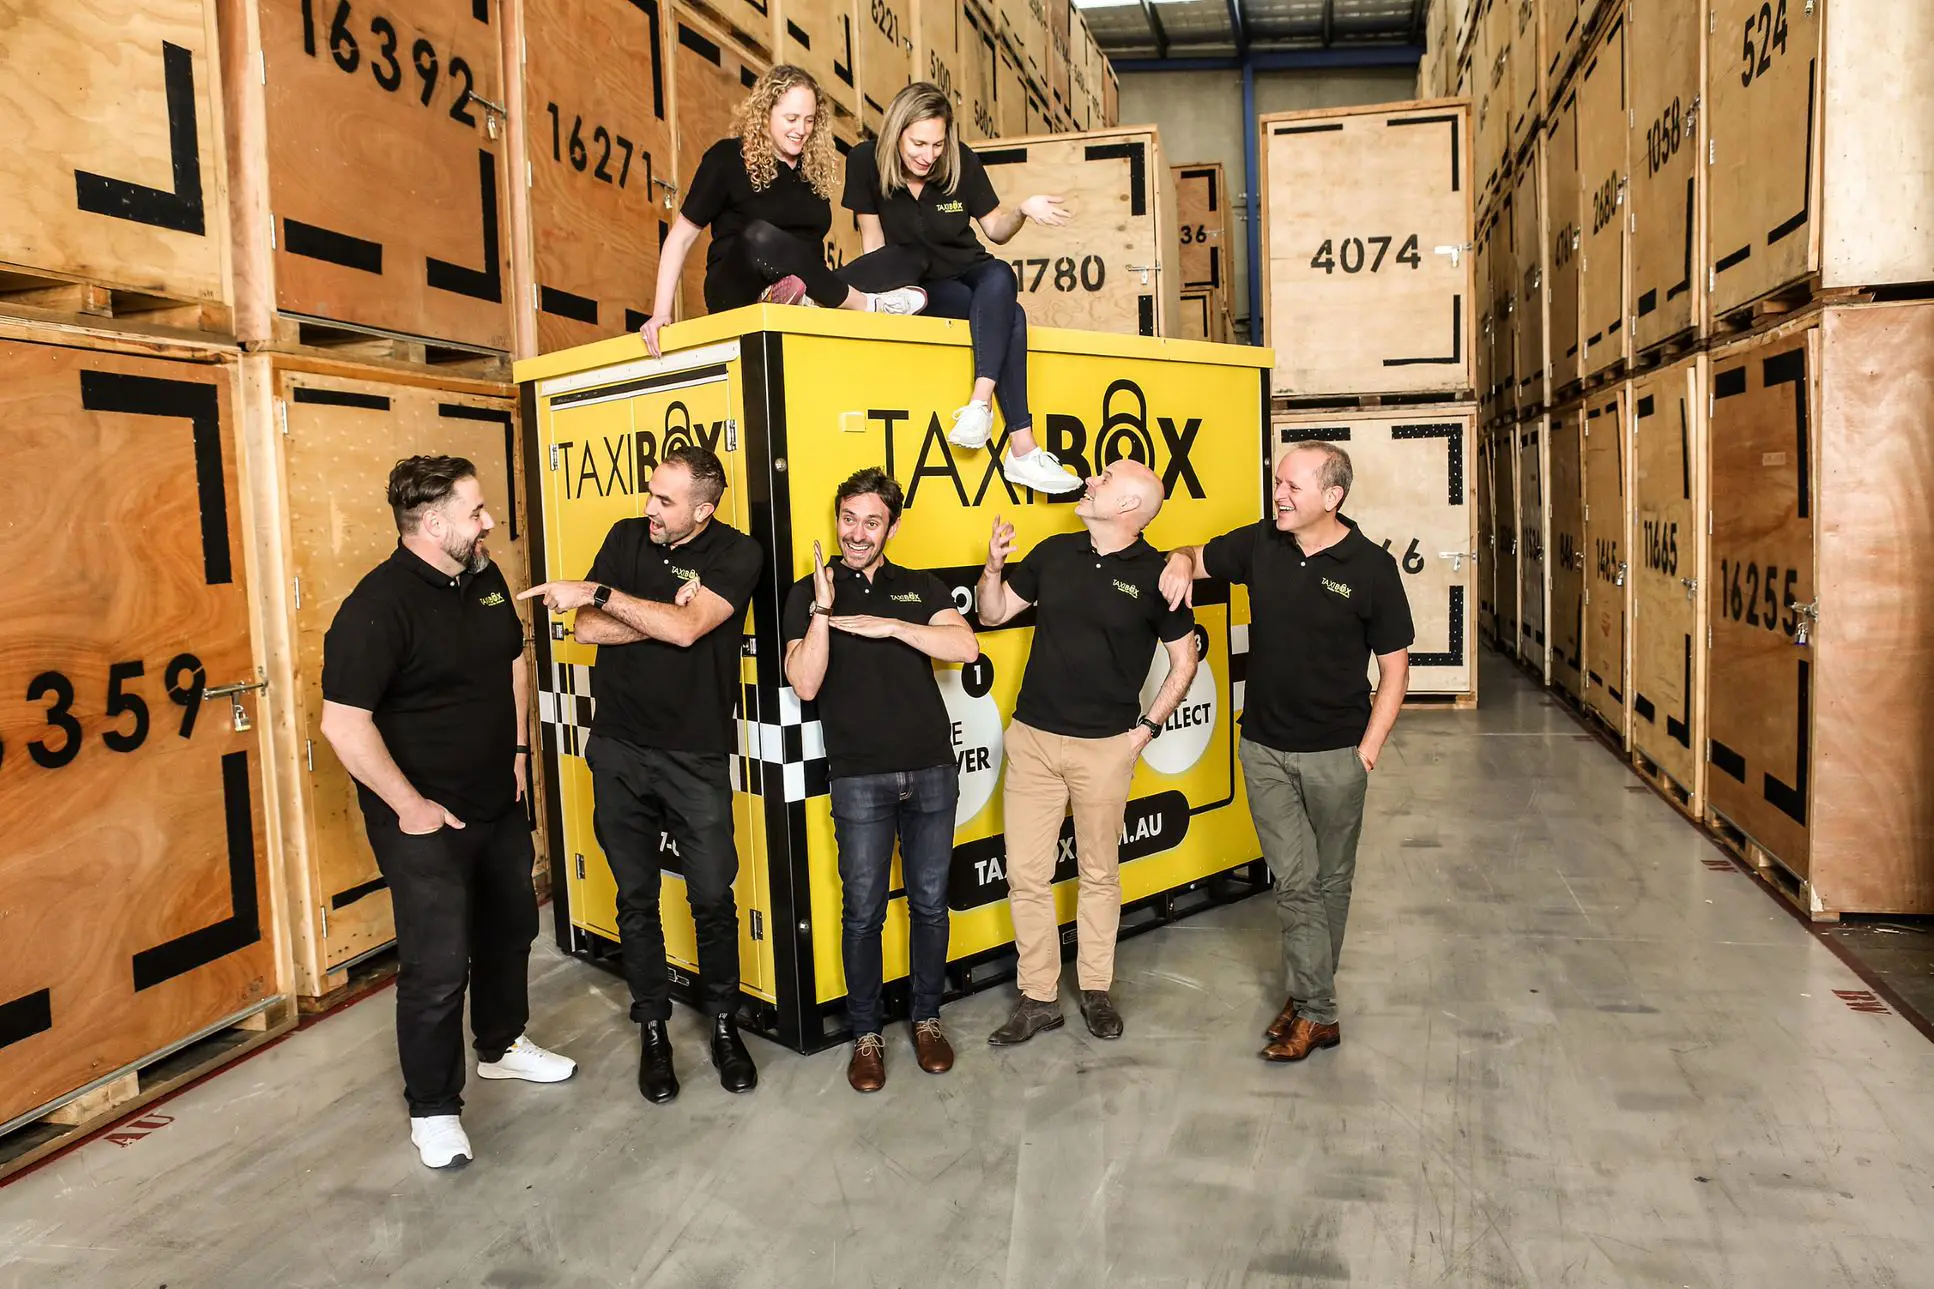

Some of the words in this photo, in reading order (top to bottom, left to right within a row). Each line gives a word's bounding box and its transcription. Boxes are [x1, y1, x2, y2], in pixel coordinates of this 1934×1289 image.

[301, 0, 476, 128] 16392
[1741, 0, 1788, 88] 524
[930, 48, 951, 97] 5100
[547, 101, 653, 203] 16271
[1647, 95, 1681, 179] 1058
[1592, 169, 1617, 236] 2680
[1180, 224, 1208, 245] 36
[1310, 233, 1422, 275] 4074
[1011, 254, 1105, 293] 1780
[867, 378, 1206, 509] TAXBOX
[1596, 538, 1617, 585] 1465
[1643, 520, 1677, 577] 11665
[1113, 579, 1139, 598] TAXIBOX
[1322, 577, 1351, 598] TAXIBOX
[1721, 558, 1798, 637] 16255
[1194, 634, 1202, 652] 3
[973, 664, 982, 686] 1
[0, 653, 206, 770] 359
[1165, 702, 1211, 732] LLECT
